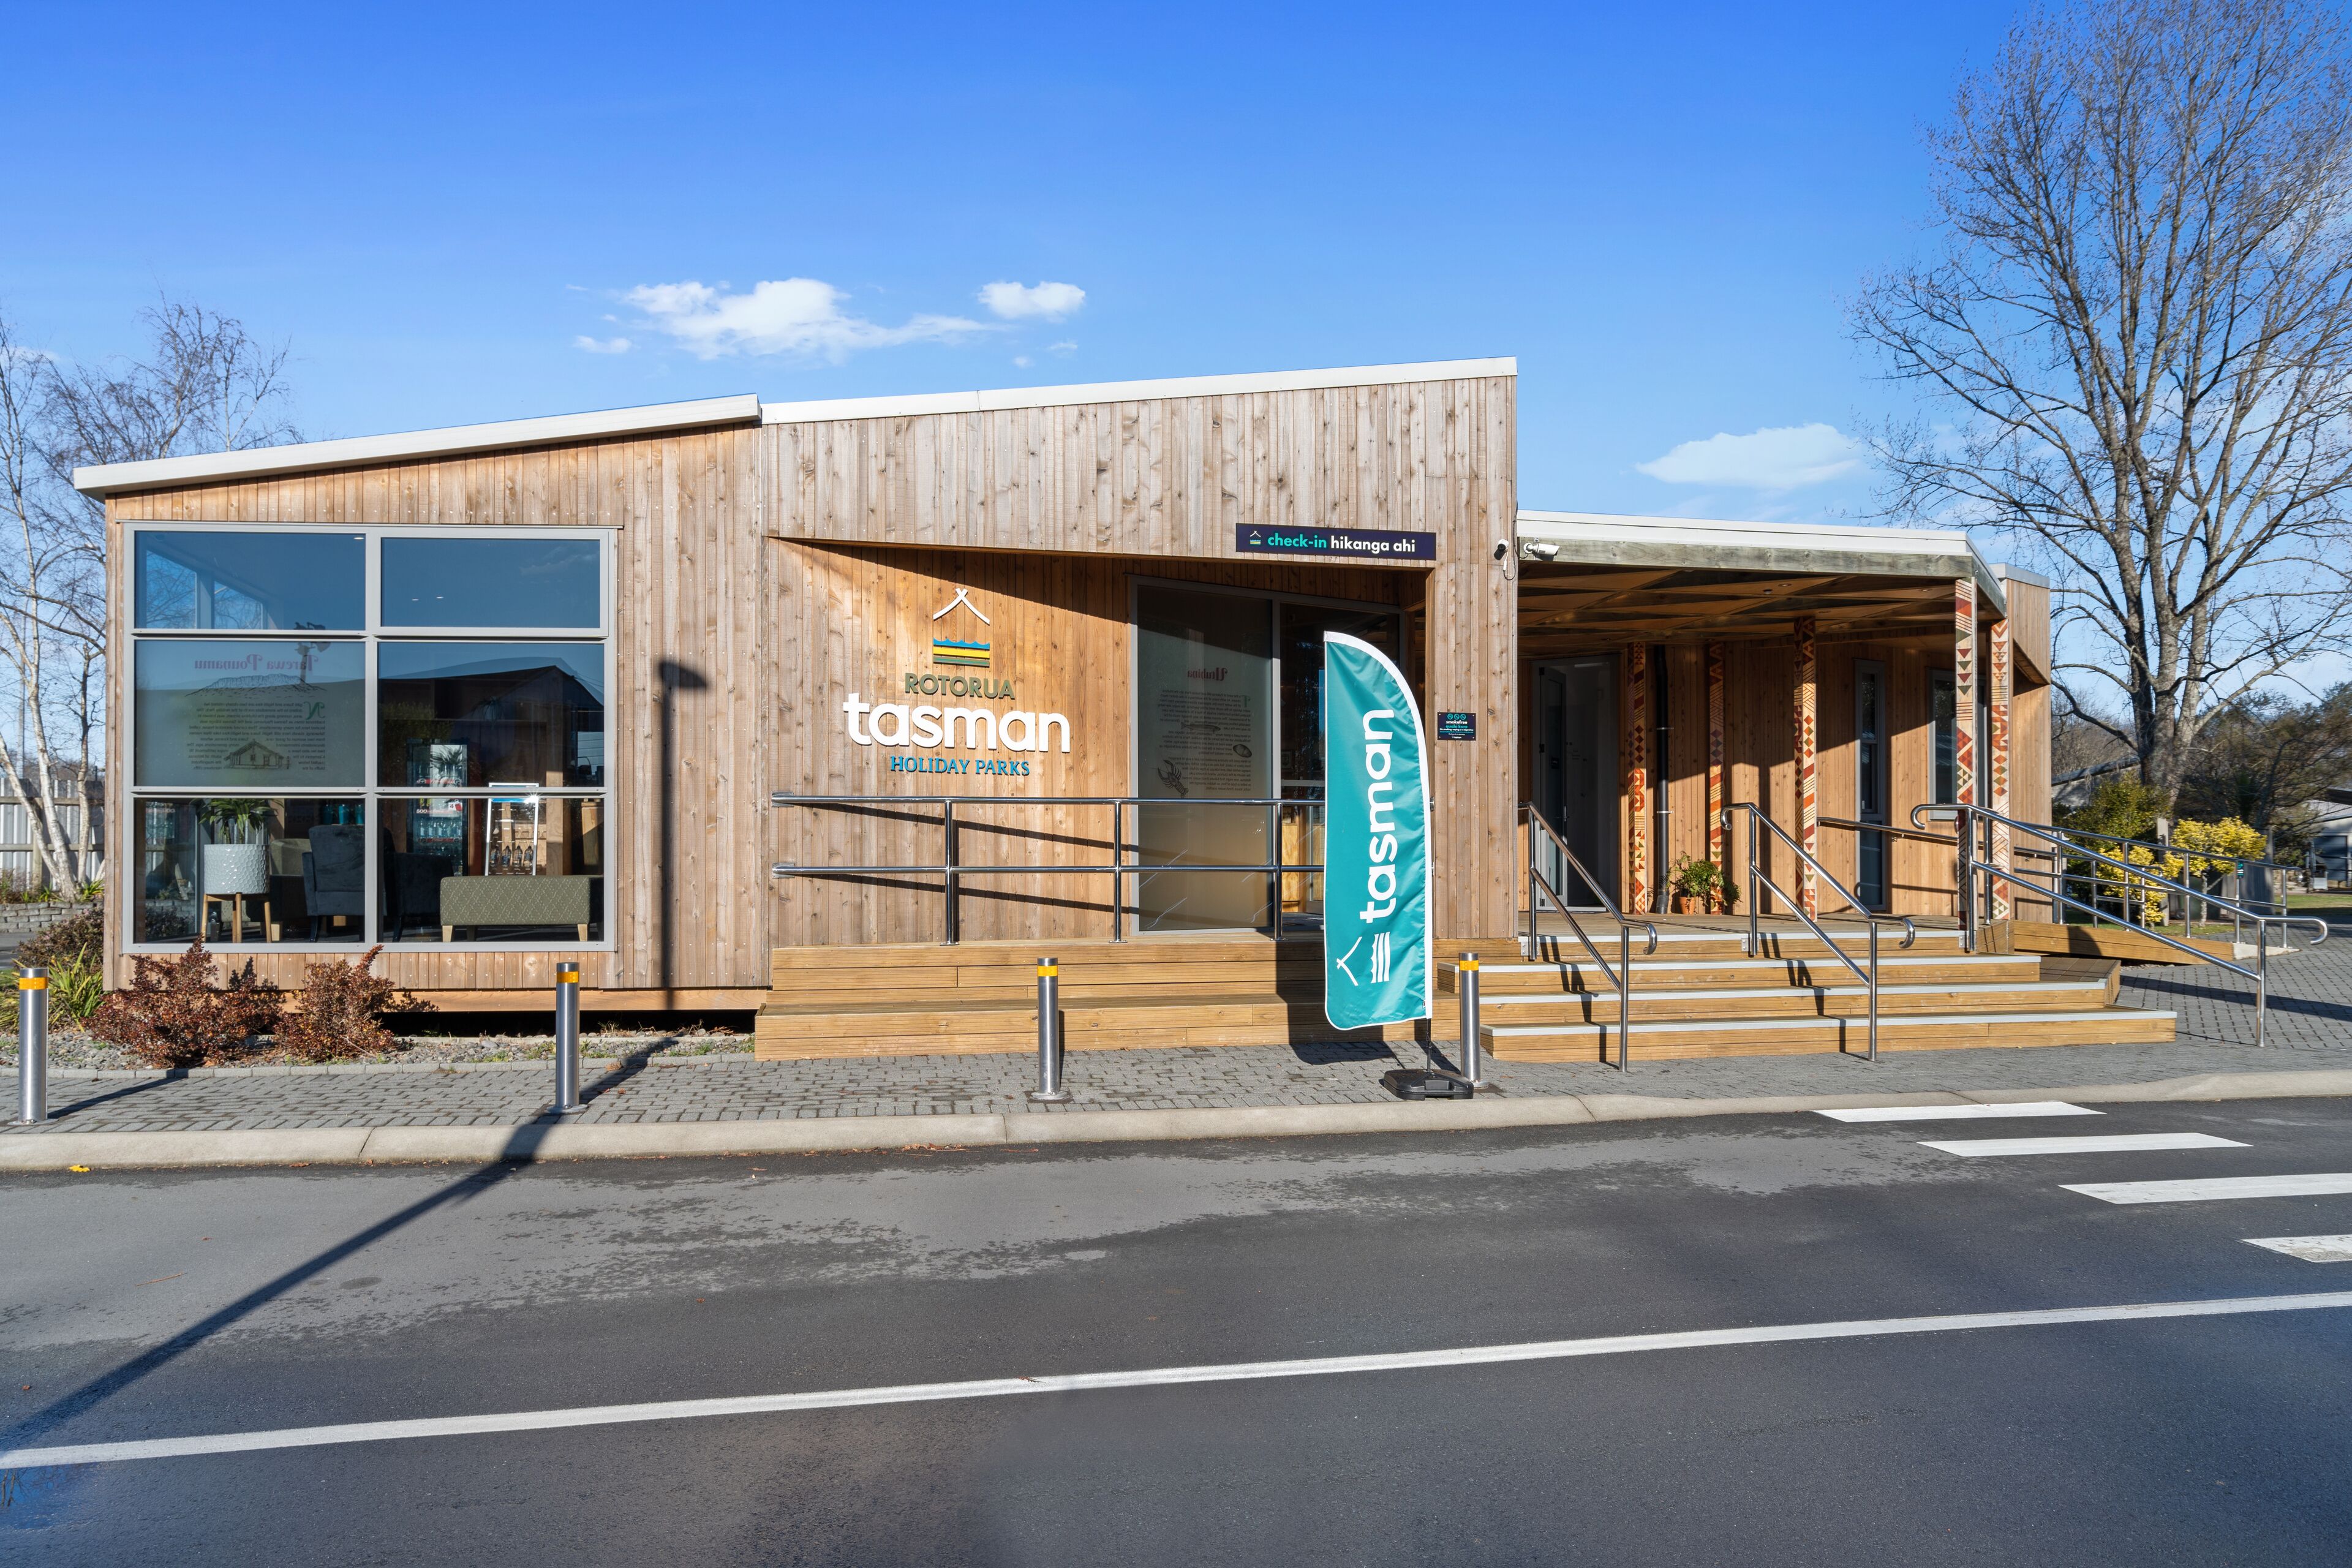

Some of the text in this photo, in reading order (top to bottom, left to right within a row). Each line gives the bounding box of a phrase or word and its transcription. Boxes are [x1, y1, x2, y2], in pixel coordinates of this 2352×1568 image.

[1267, 532, 1416, 555] check-in hikanga ahi
[905, 673, 1016, 699] ROTORUA
[843, 692, 1071, 753] tasman
[890, 755, 1030, 776] HOLIDAY PARKS
[1359, 709, 1399, 924] tasman
